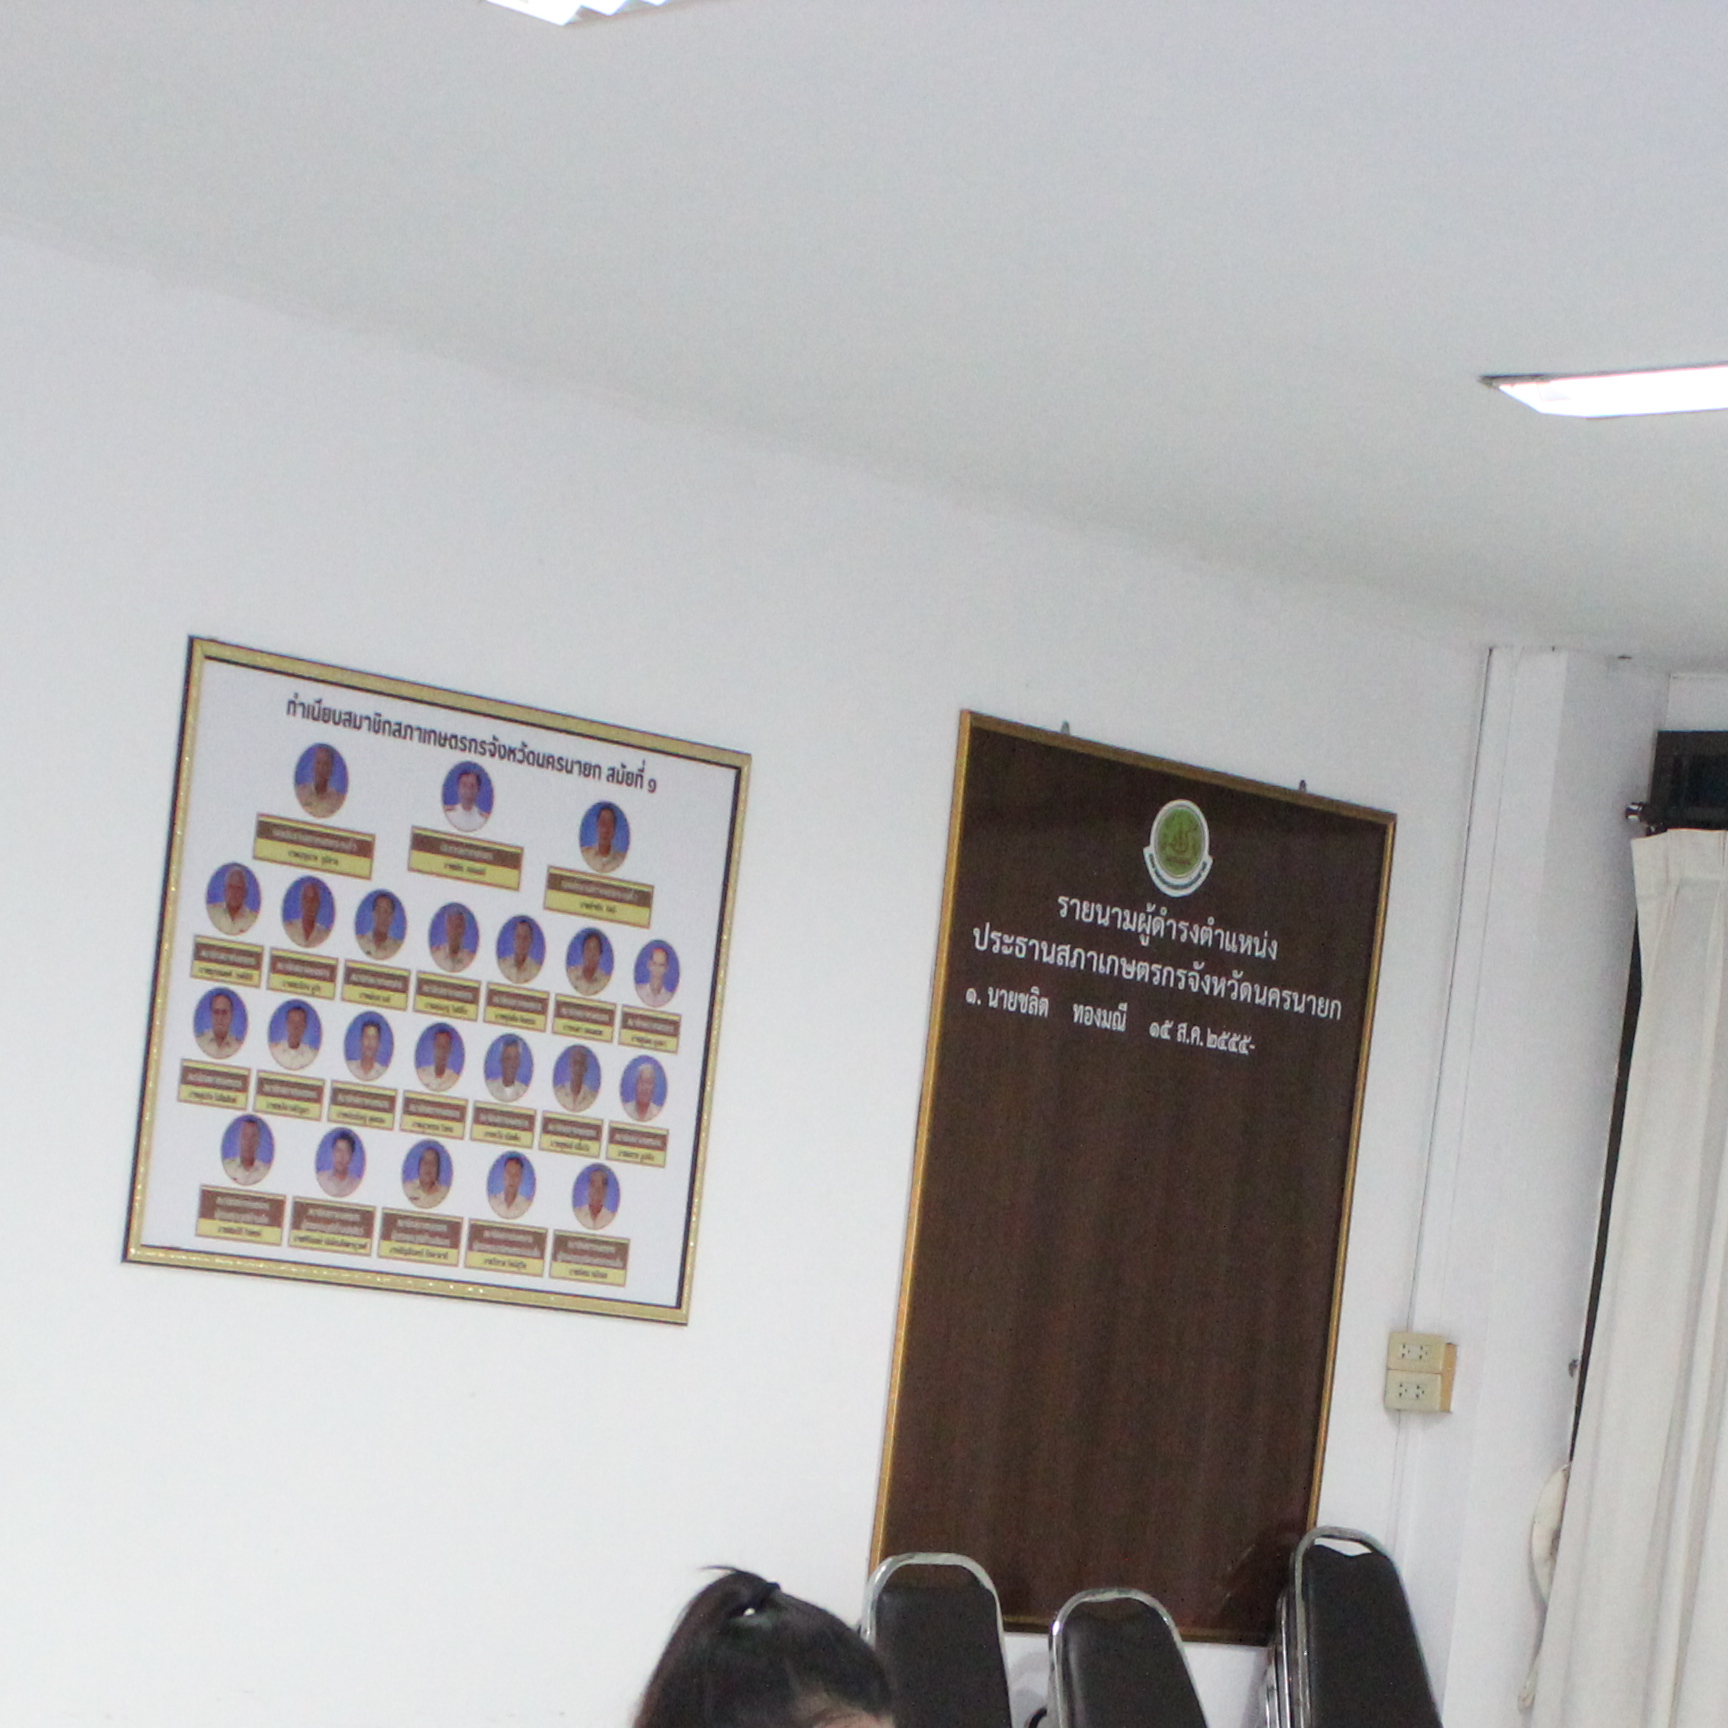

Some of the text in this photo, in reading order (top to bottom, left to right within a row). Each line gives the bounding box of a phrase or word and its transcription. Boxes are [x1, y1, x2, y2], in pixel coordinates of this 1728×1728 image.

[606, 759, 646, 790] สมัยที่
[1057, 895, 1279, 961] รายนามผู้ดำรงตำแหน่ง
[972, 922, 1342, 1020] ประธานสภาเกษตรกรจังหวัดนครนายก
[1072, 1002, 1129, 1032] ทองมณี
